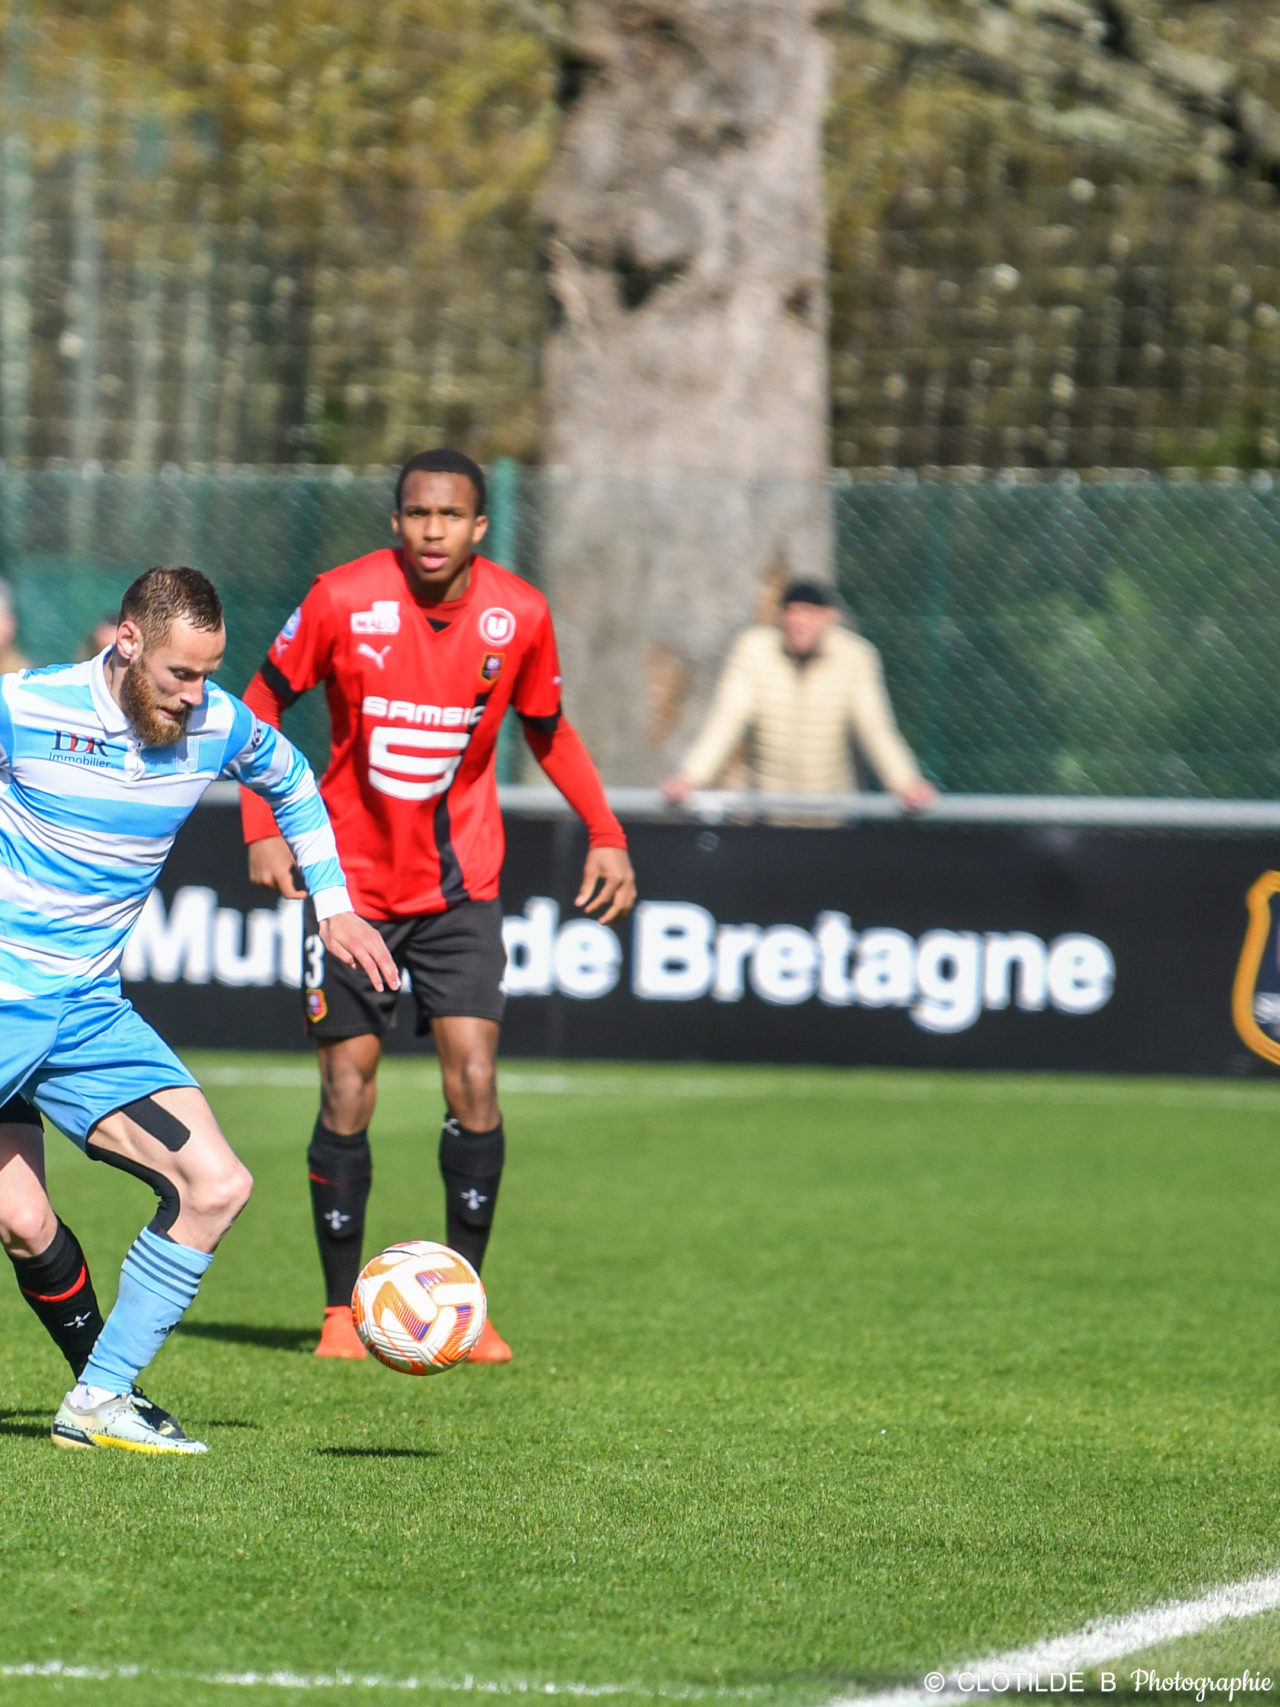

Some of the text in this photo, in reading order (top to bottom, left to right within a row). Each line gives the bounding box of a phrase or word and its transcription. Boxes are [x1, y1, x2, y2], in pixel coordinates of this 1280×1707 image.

[362, 695, 487, 728] SAMSIC
[52, 729, 108, 757] DDR
[49, 752, 111, 768] Immobilier
[122, 885, 1117, 1034] Mut de Bretagne
[304, 934, 325, 989] 3
